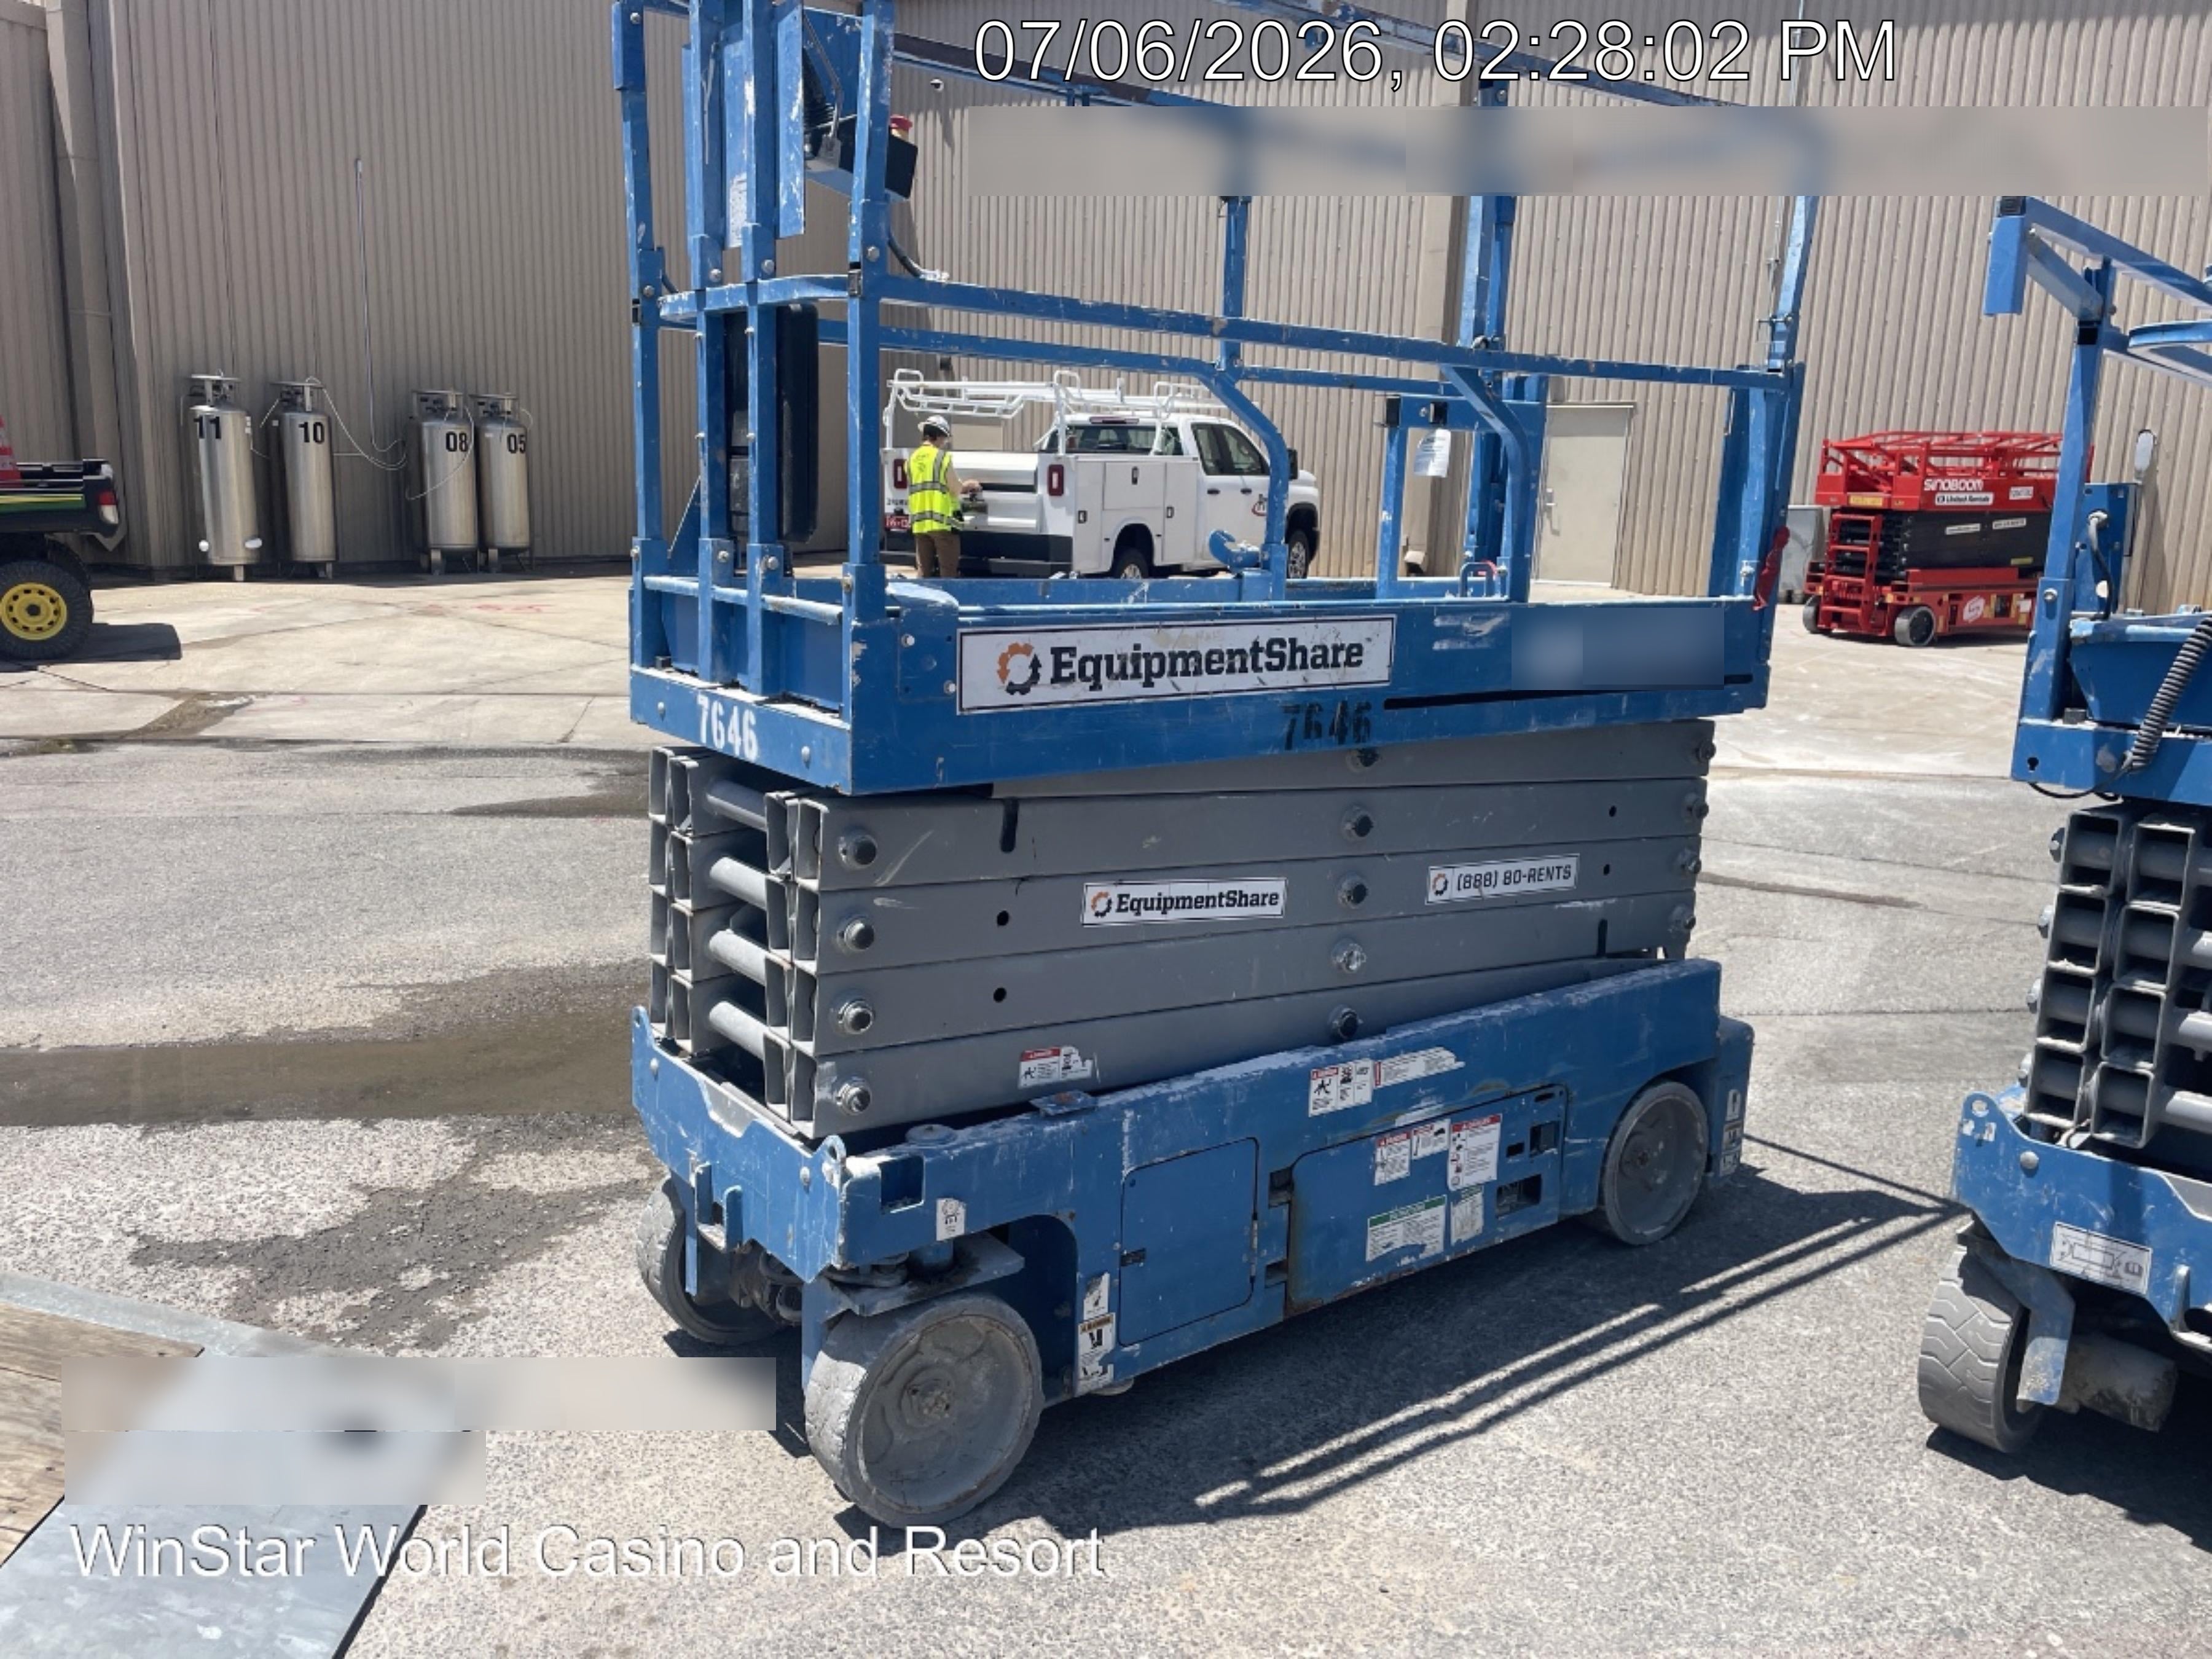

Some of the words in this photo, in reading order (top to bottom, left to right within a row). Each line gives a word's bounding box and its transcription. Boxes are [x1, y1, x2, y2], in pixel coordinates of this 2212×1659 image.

[194, 416, 221, 439] 11
[299, 422, 324, 444] 10
[445, 431, 468, 452] 08
[507, 433, 527, 454] 05
[1049, 637, 1364, 692] EquipmentShare
[697, 692, 759, 761] 7646
[1282, 699, 1371, 750] 7646
[1457, 869, 1499, 891] (888)
[1503, 864, 1572, 885] 80-RENTS
[1115, 889, 1279, 916] EquipmentShare
